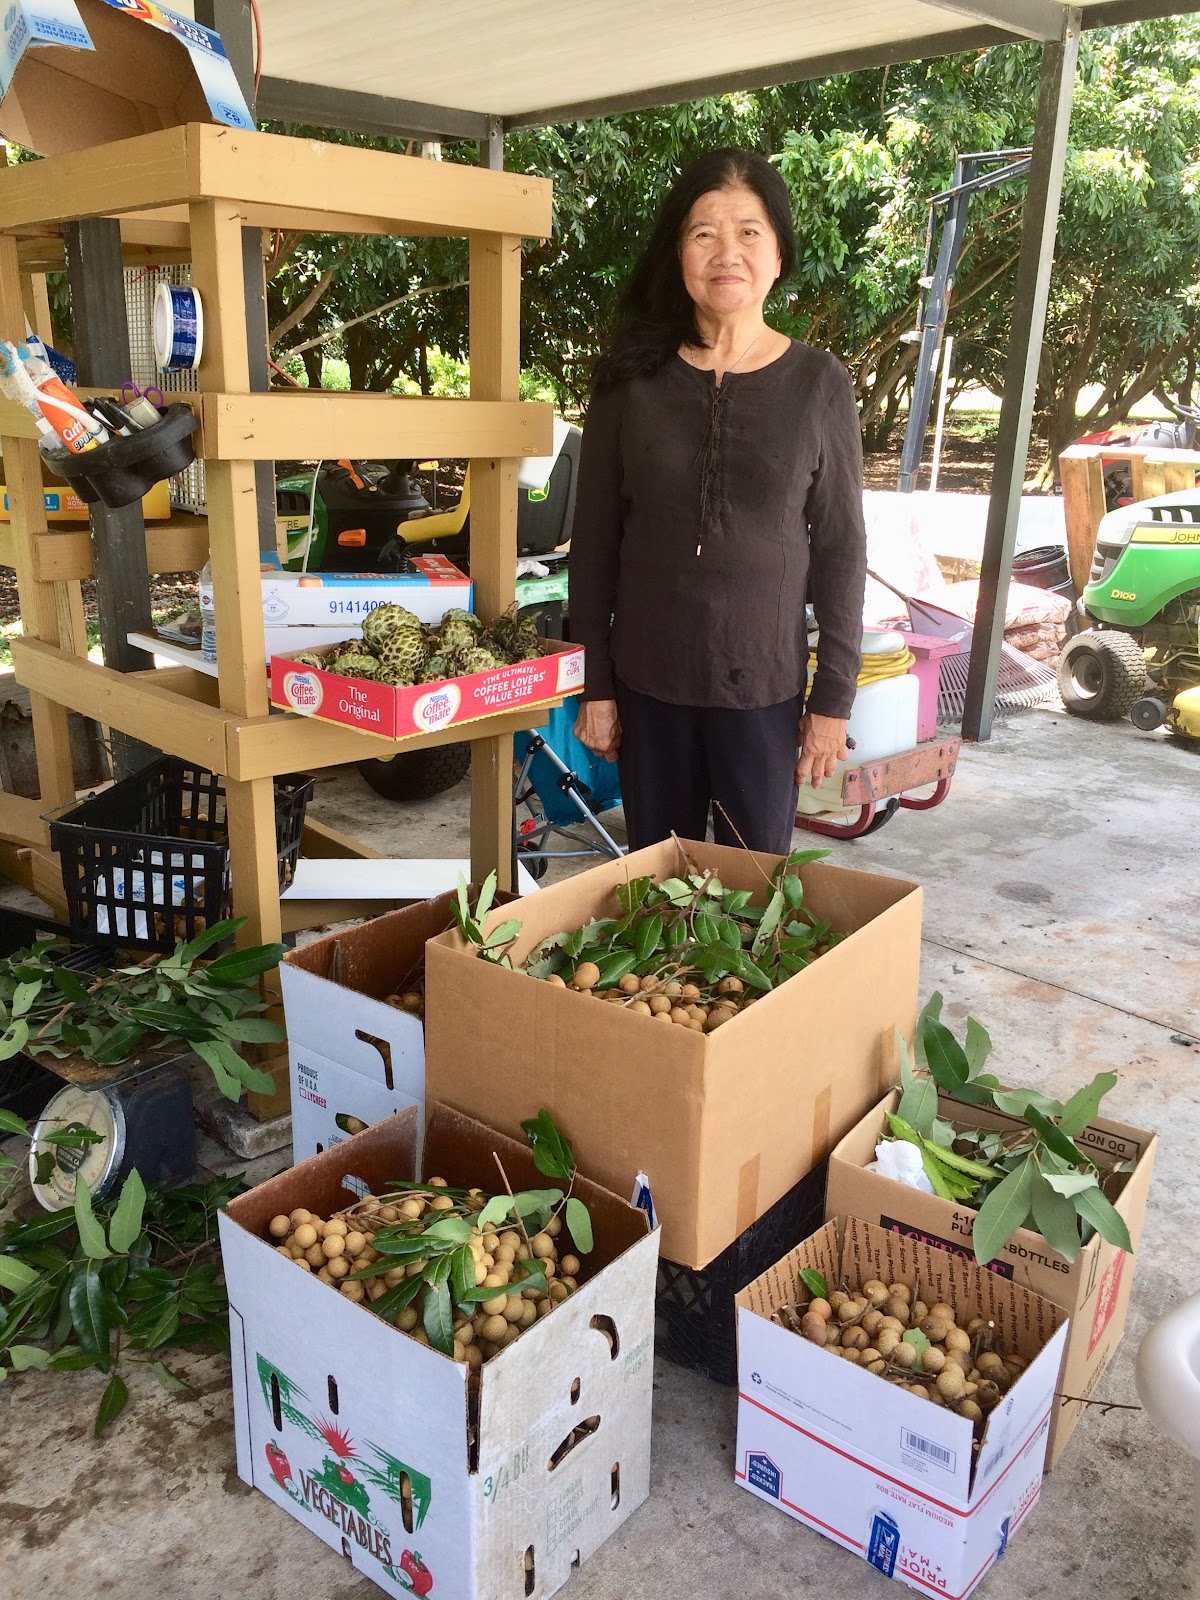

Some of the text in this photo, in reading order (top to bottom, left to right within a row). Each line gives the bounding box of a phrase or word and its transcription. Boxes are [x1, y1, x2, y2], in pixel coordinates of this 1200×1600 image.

[36, 27, 89, 45] FRAGRANCE
[62, 419, 85, 442] Cutt
[1110, 589, 1137, 601] D100
[297, 695, 317, 705] mate
[348, 685, 368, 703] The
[473, 682, 509, 698] COFFEE
[484, 690, 513, 705] VALUE
[514, 686, 533, 698] SIZE
[339, 699, 380, 723] Original
[428, 707, 453, 725] mate
[297, 1062, 319, 1081] PRODUCE
[1079, 1131, 1126, 1153] DO NOT
[865, 1233, 873, 1263] required
[1008, 1243, 1071, 1275] BOTTLES
[899, 1247, 907, 1274] Service
[926, 1257, 934, 1287] required
[962, 1271, 970, 1299] Service
[875, 1483, 954, 1528] MEDIUM FLAT RATE BOX
[298, 1468, 394, 1567] VEGETABLES
[902, 1545, 930, 1567] MAI
[898, 1554, 947, 1589] PRIOR
